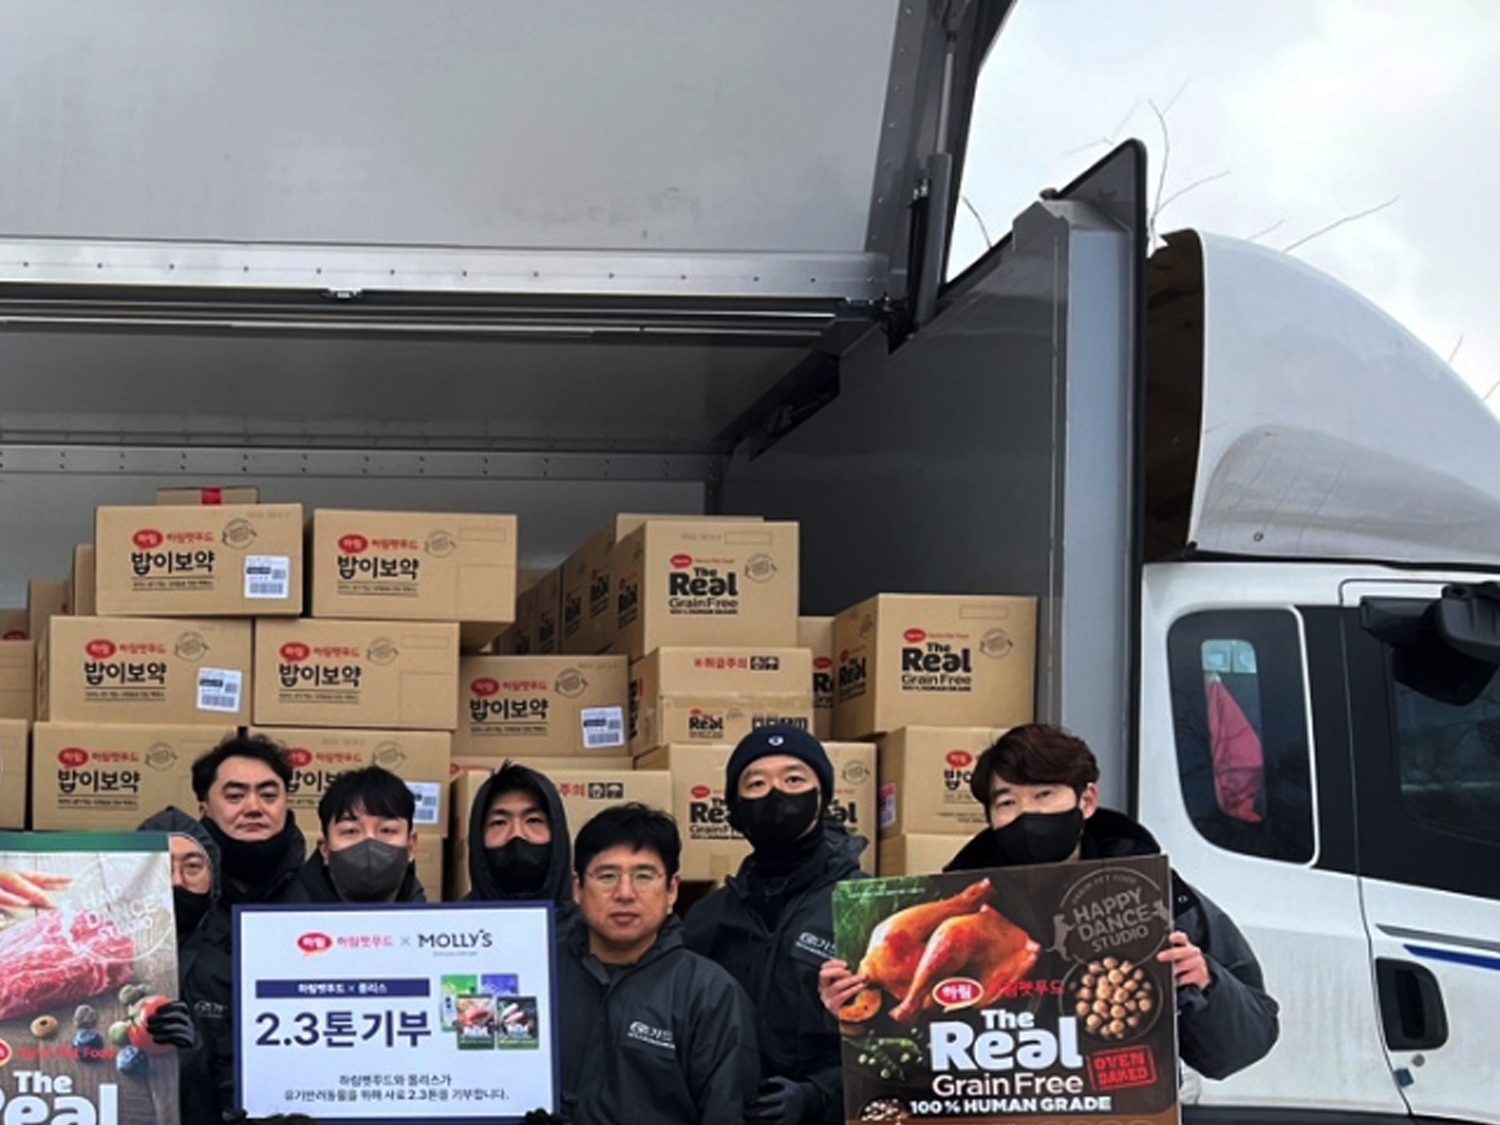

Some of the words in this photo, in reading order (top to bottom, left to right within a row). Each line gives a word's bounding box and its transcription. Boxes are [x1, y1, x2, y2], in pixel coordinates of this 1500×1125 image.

[131, 551, 215, 575] 밥이보약
[337, 556, 419, 579] 밥이보약
[694, 567, 717, 577] The
[669, 572, 738, 596] Real
[927, 642, 952, 653] The
[902, 647, 972, 673] Real
[85, 662, 167, 685] 밥이보약
[279, 663, 361, 687] 밥이보약
[902, 674, 938, 686] Grain
[940, 674, 972, 686] Free
[470, 698, 548, 721] 밥이보약
[58, 770, 140, 793] 밥이보약
[1073, 887, 1142, 923] HAPPY
[1079, 904, 1151, 940] DANCE
[336, 935, 394, 949] 하림펫푸드
[418, 929, 493, 948] MOLLY'S
[1092, 925, 1149, 952] STUDIO
[941, 983, 972, 1000] 하림
[981, 1009, 1034, 1029] The
[929, 1016, 1082, 1072] Real
[1094, 1052, 1145, 1070] OVEN
[14, 1071, 73, 1093] The
[932, 1073, 1011, 1097] Grain
[1016, 1072, 1083, 1094] Free
[964, 1098, 1037, 1113] HUMAN
[1041, 1096, 1112, 1111] GRADE
